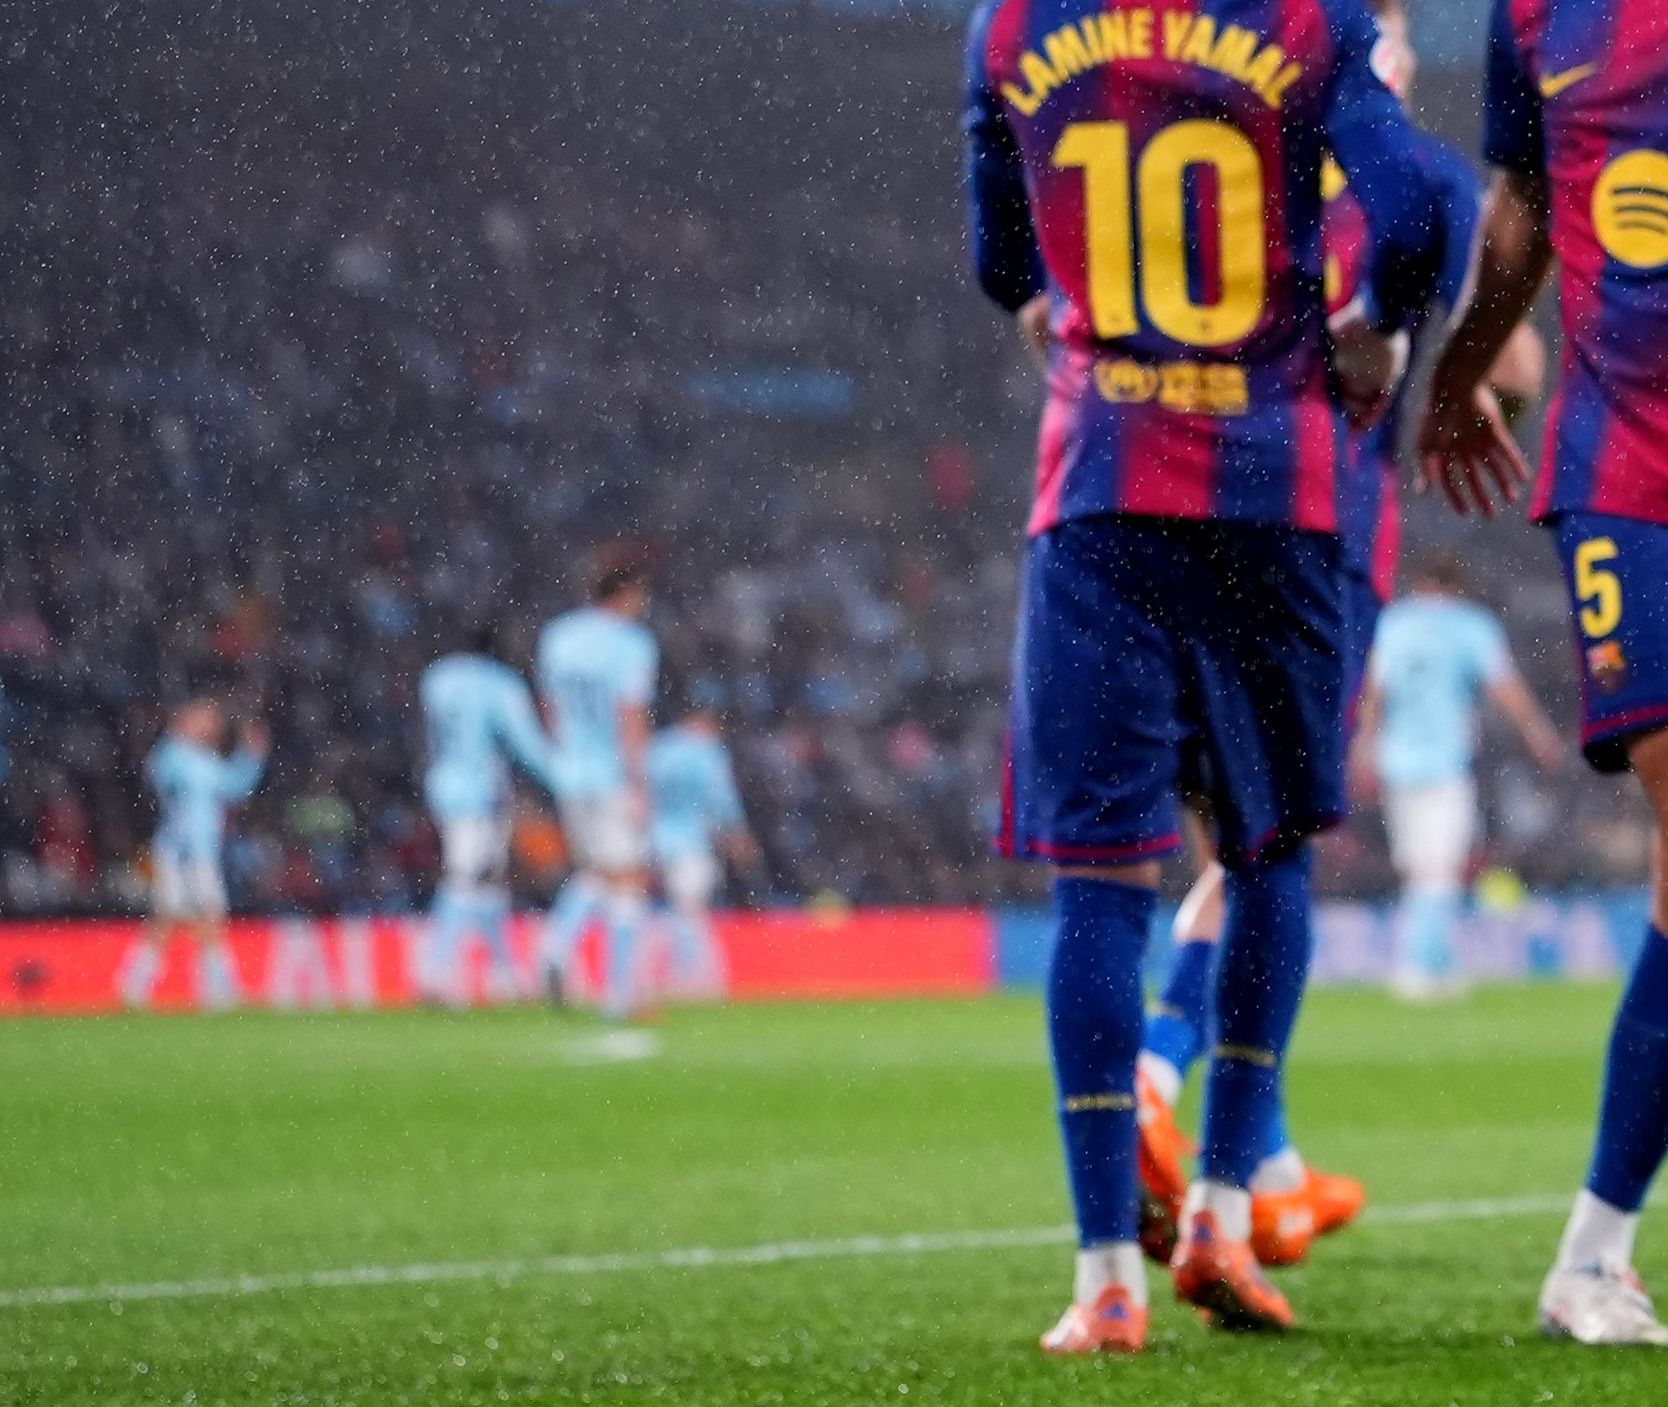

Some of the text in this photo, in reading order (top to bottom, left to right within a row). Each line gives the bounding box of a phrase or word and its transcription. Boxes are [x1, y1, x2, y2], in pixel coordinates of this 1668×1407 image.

[1000, 8, 1301, 117] LAMINE YAMAL
[1052, 118, 1267, 348] 10
[1574, 535, 1624, 639] 5
